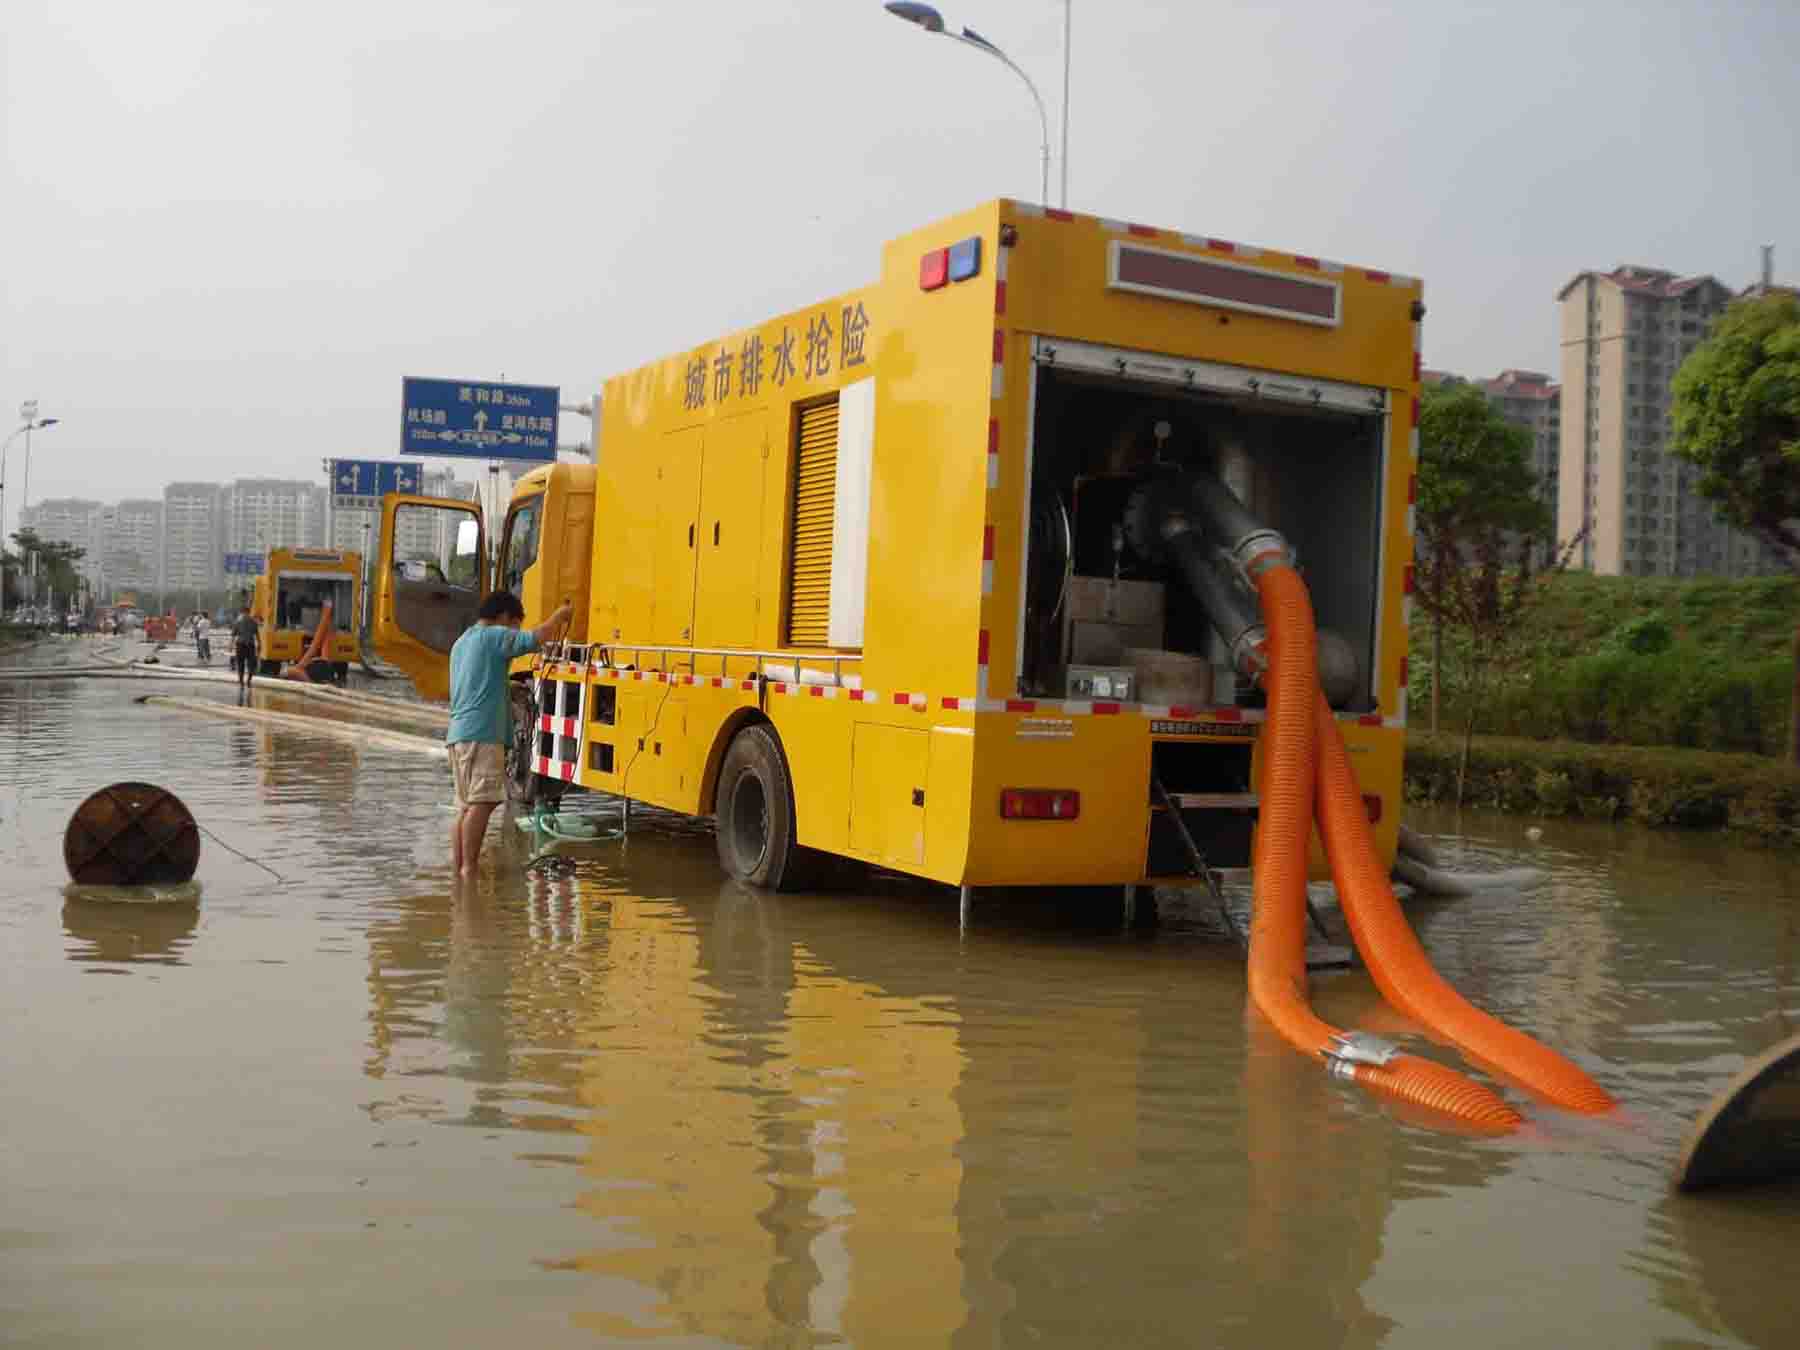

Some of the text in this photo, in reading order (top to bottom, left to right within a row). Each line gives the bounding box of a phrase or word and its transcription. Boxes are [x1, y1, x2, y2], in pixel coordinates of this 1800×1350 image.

[683, 301, 869, 411] 城市排水抢险
